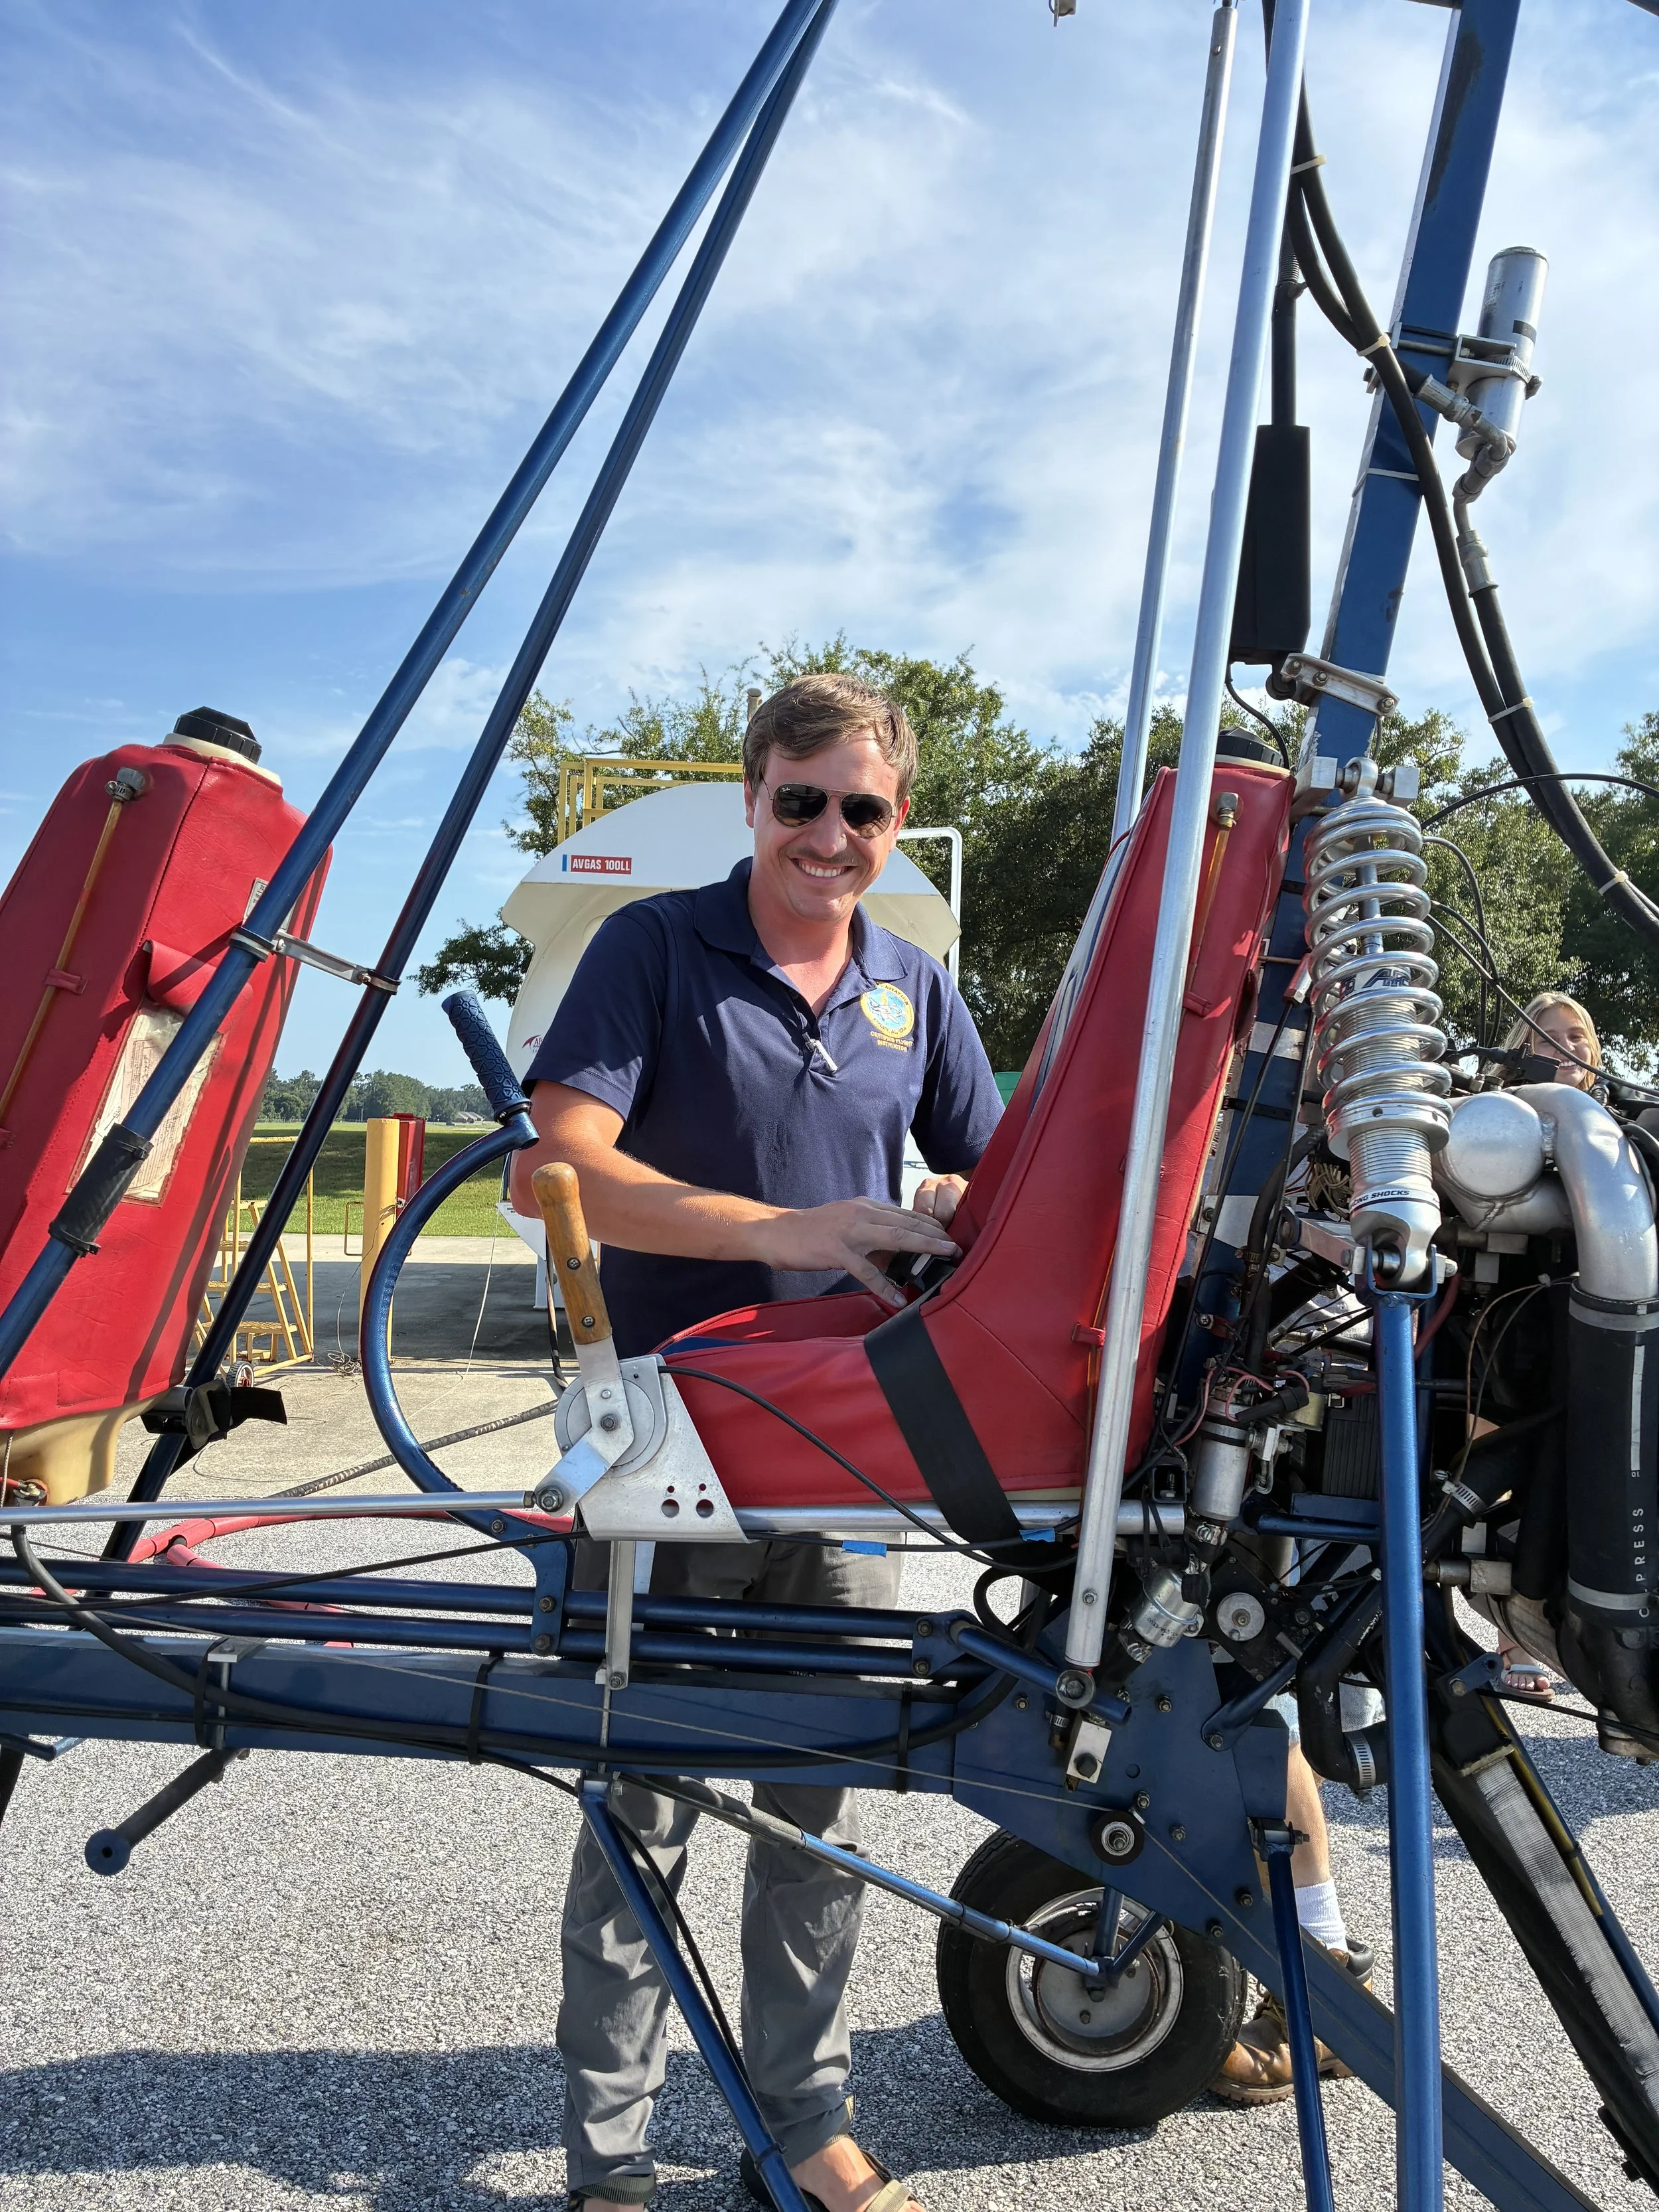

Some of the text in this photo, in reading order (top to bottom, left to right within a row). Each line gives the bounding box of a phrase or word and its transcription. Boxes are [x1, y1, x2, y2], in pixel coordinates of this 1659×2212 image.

[572, 858, 630, 871] AVGAS 100LL
[1370, 1190, 1410, 1199] SHOCKS
